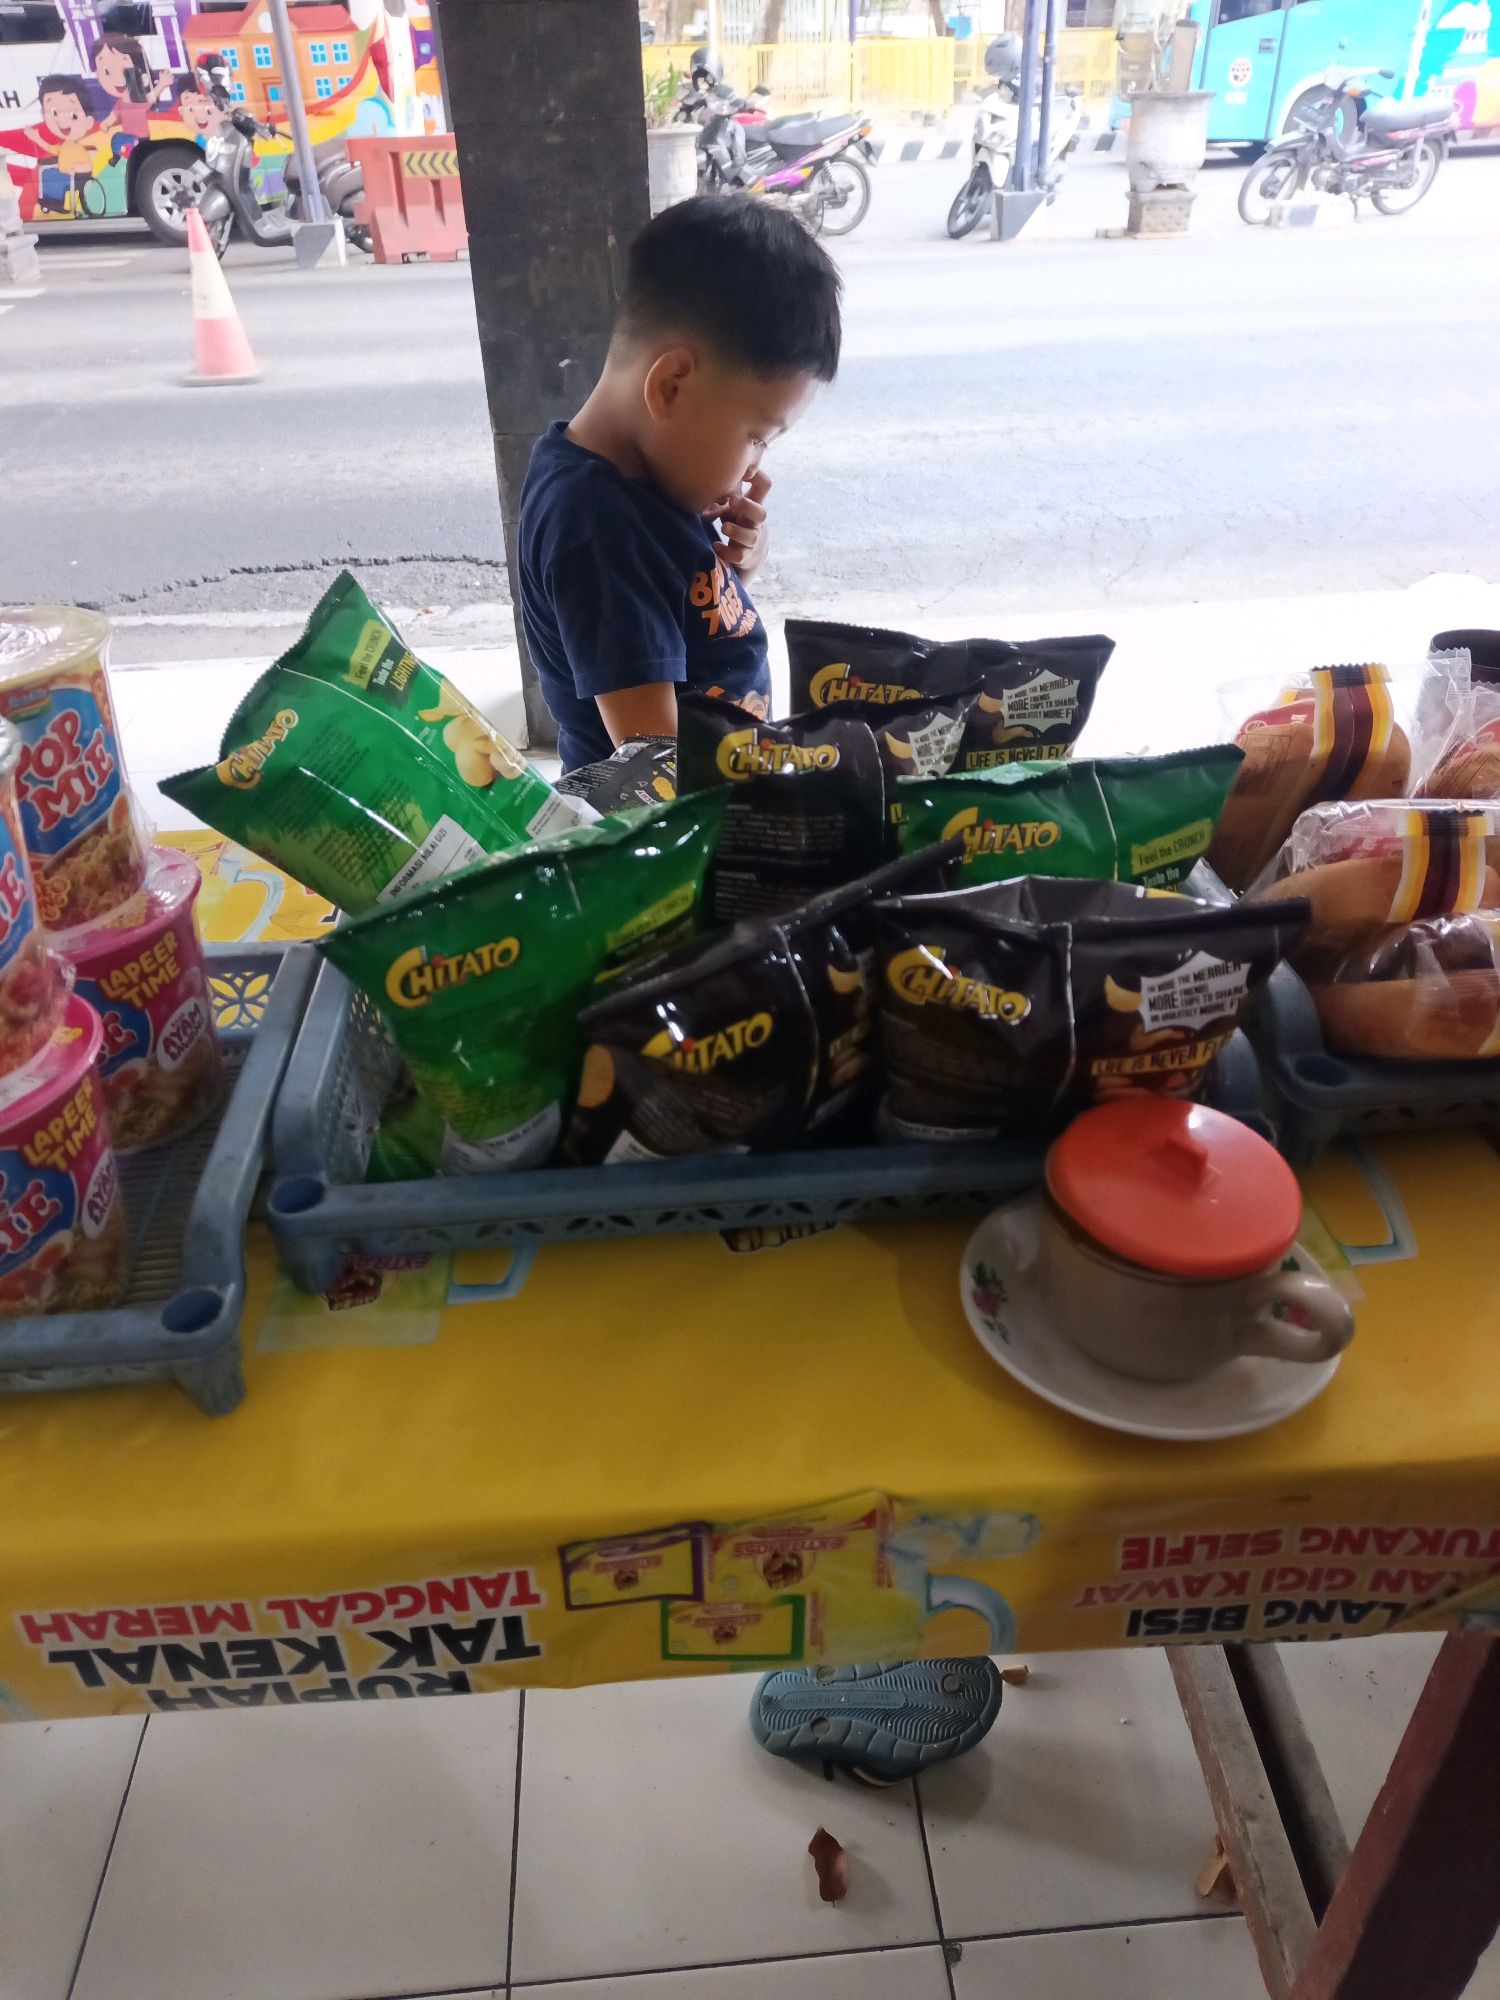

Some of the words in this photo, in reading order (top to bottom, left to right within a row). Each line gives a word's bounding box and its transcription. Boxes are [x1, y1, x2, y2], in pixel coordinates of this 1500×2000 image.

[1008, 698, 1029, 711] MORE
[101, 931, 178, 998] LAPEER
[122, 956, 180, 1009] TIME
[1149, 991, 1178, 1012] MORE
[1121, 1529, 1284, 1571] SELFIE
[267, 1571, 540, 1630] TANGGAL
[1074, 1569, 1252, 1608] KAWAT
[1261, 1566, 1358, 1595] GIGI
[20, 1602, 253, 1644] MERAH
[1126, 1603, 1250, 1638] BESI
[48, 1636, 348, 1688] KENAL
[367, 1615, 541, 1671] TAK
[148, 1671, 473, 1712] RUPIAH
